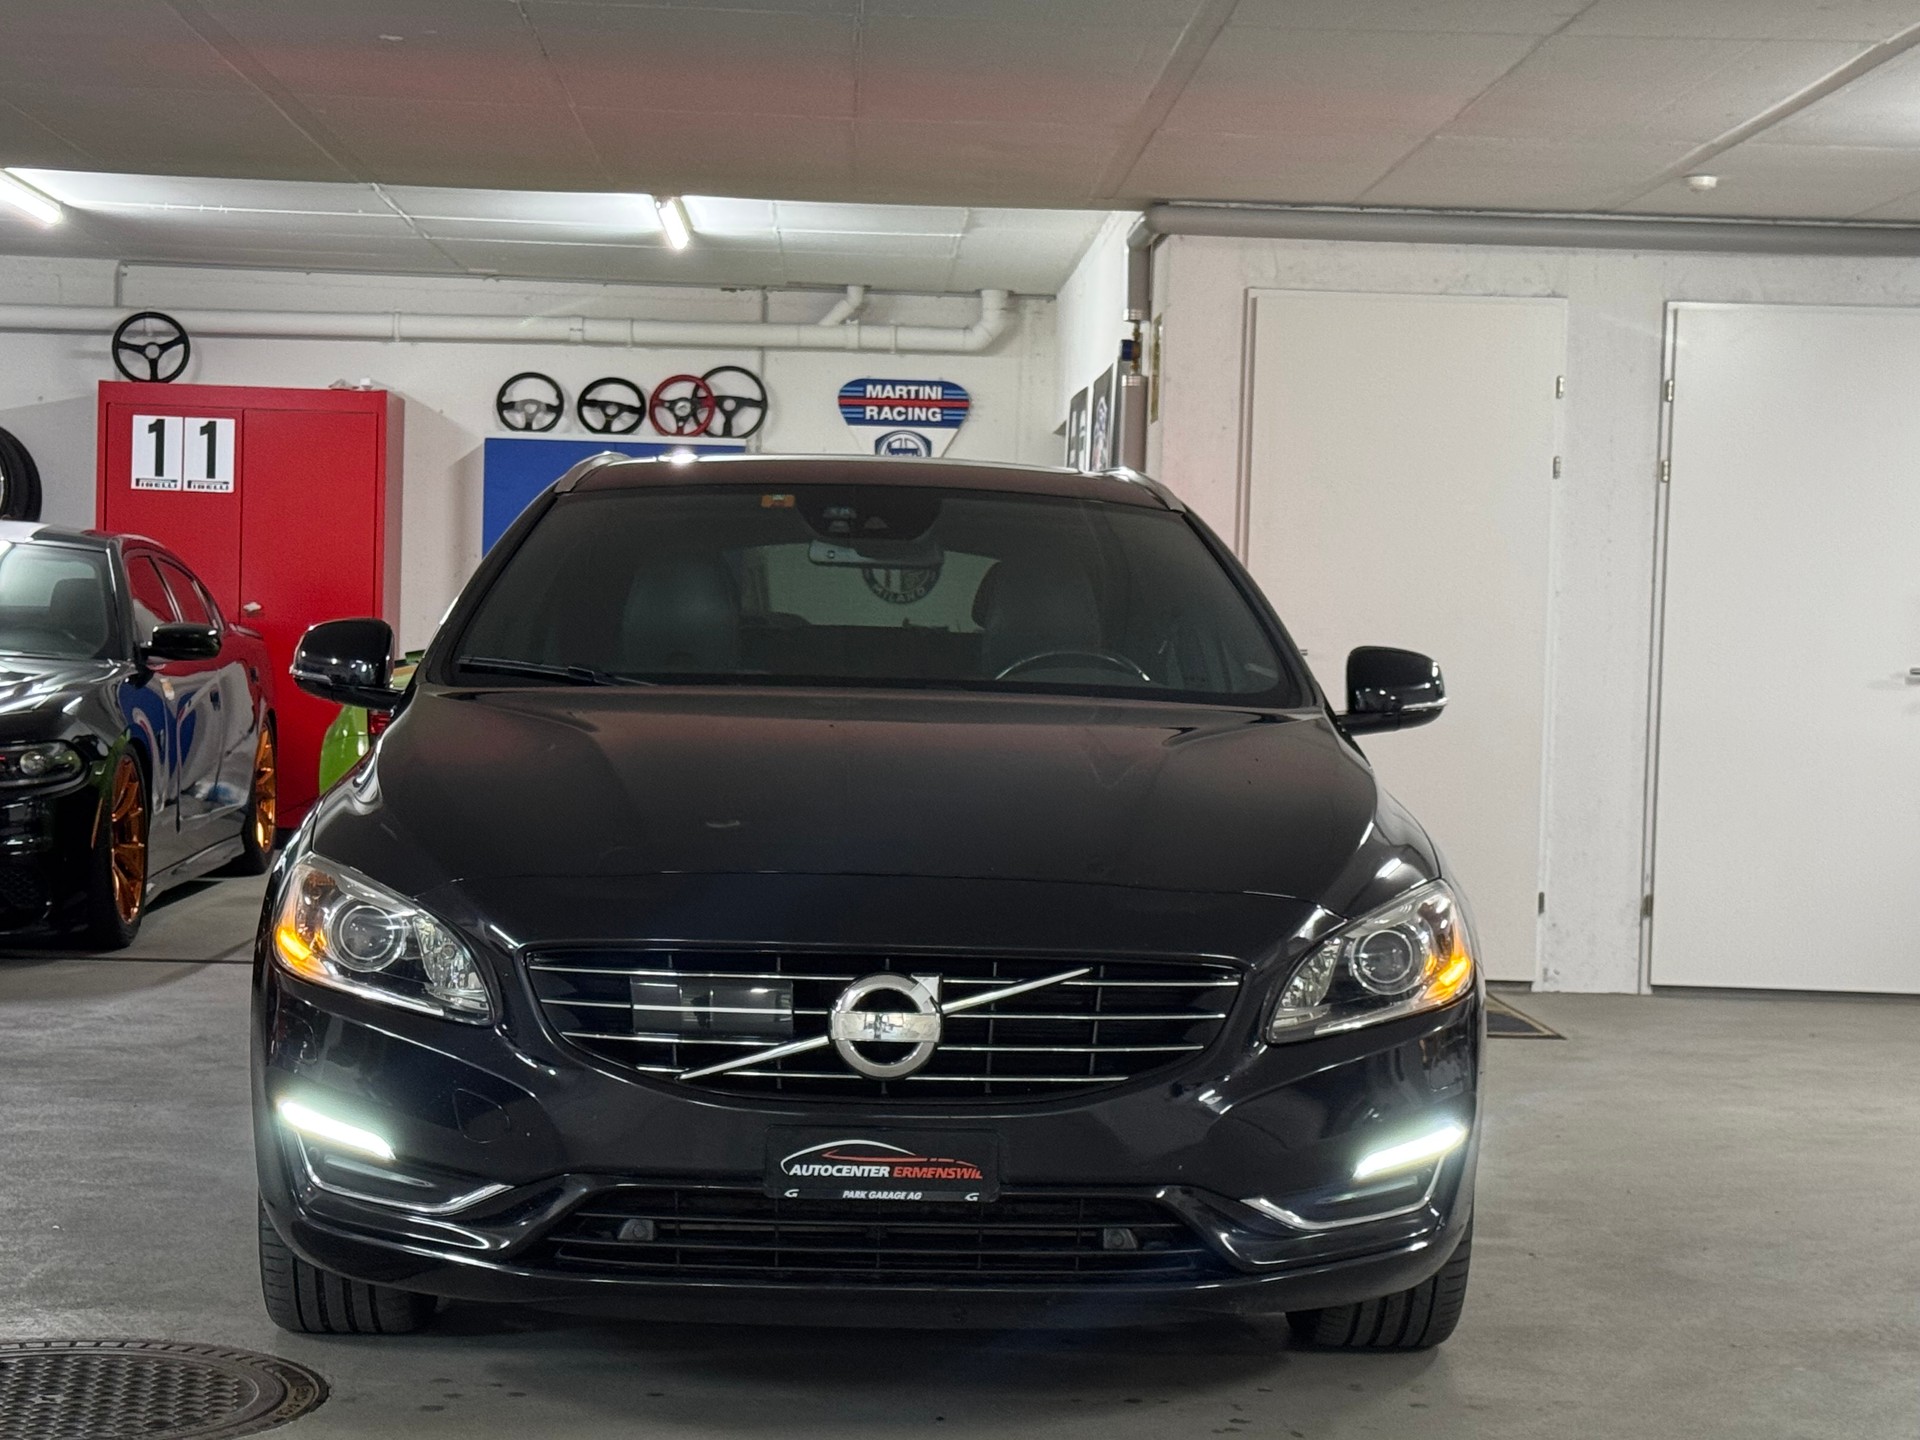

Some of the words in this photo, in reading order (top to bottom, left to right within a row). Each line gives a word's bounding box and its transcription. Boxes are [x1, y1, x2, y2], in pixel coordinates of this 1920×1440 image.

[865, 384, 943, 400] MARTINI
[865, 405, 942, 422] RACING
[788, 1164, 890, 1178] AUTOCENTER
[893, 1165, 983, 1179] ERMENSWIL
[842, 1190, 867, 1199] PARK
[868, 1190, 907, 1200] GARAGE
[906, 1191, 922, 1200] AG
